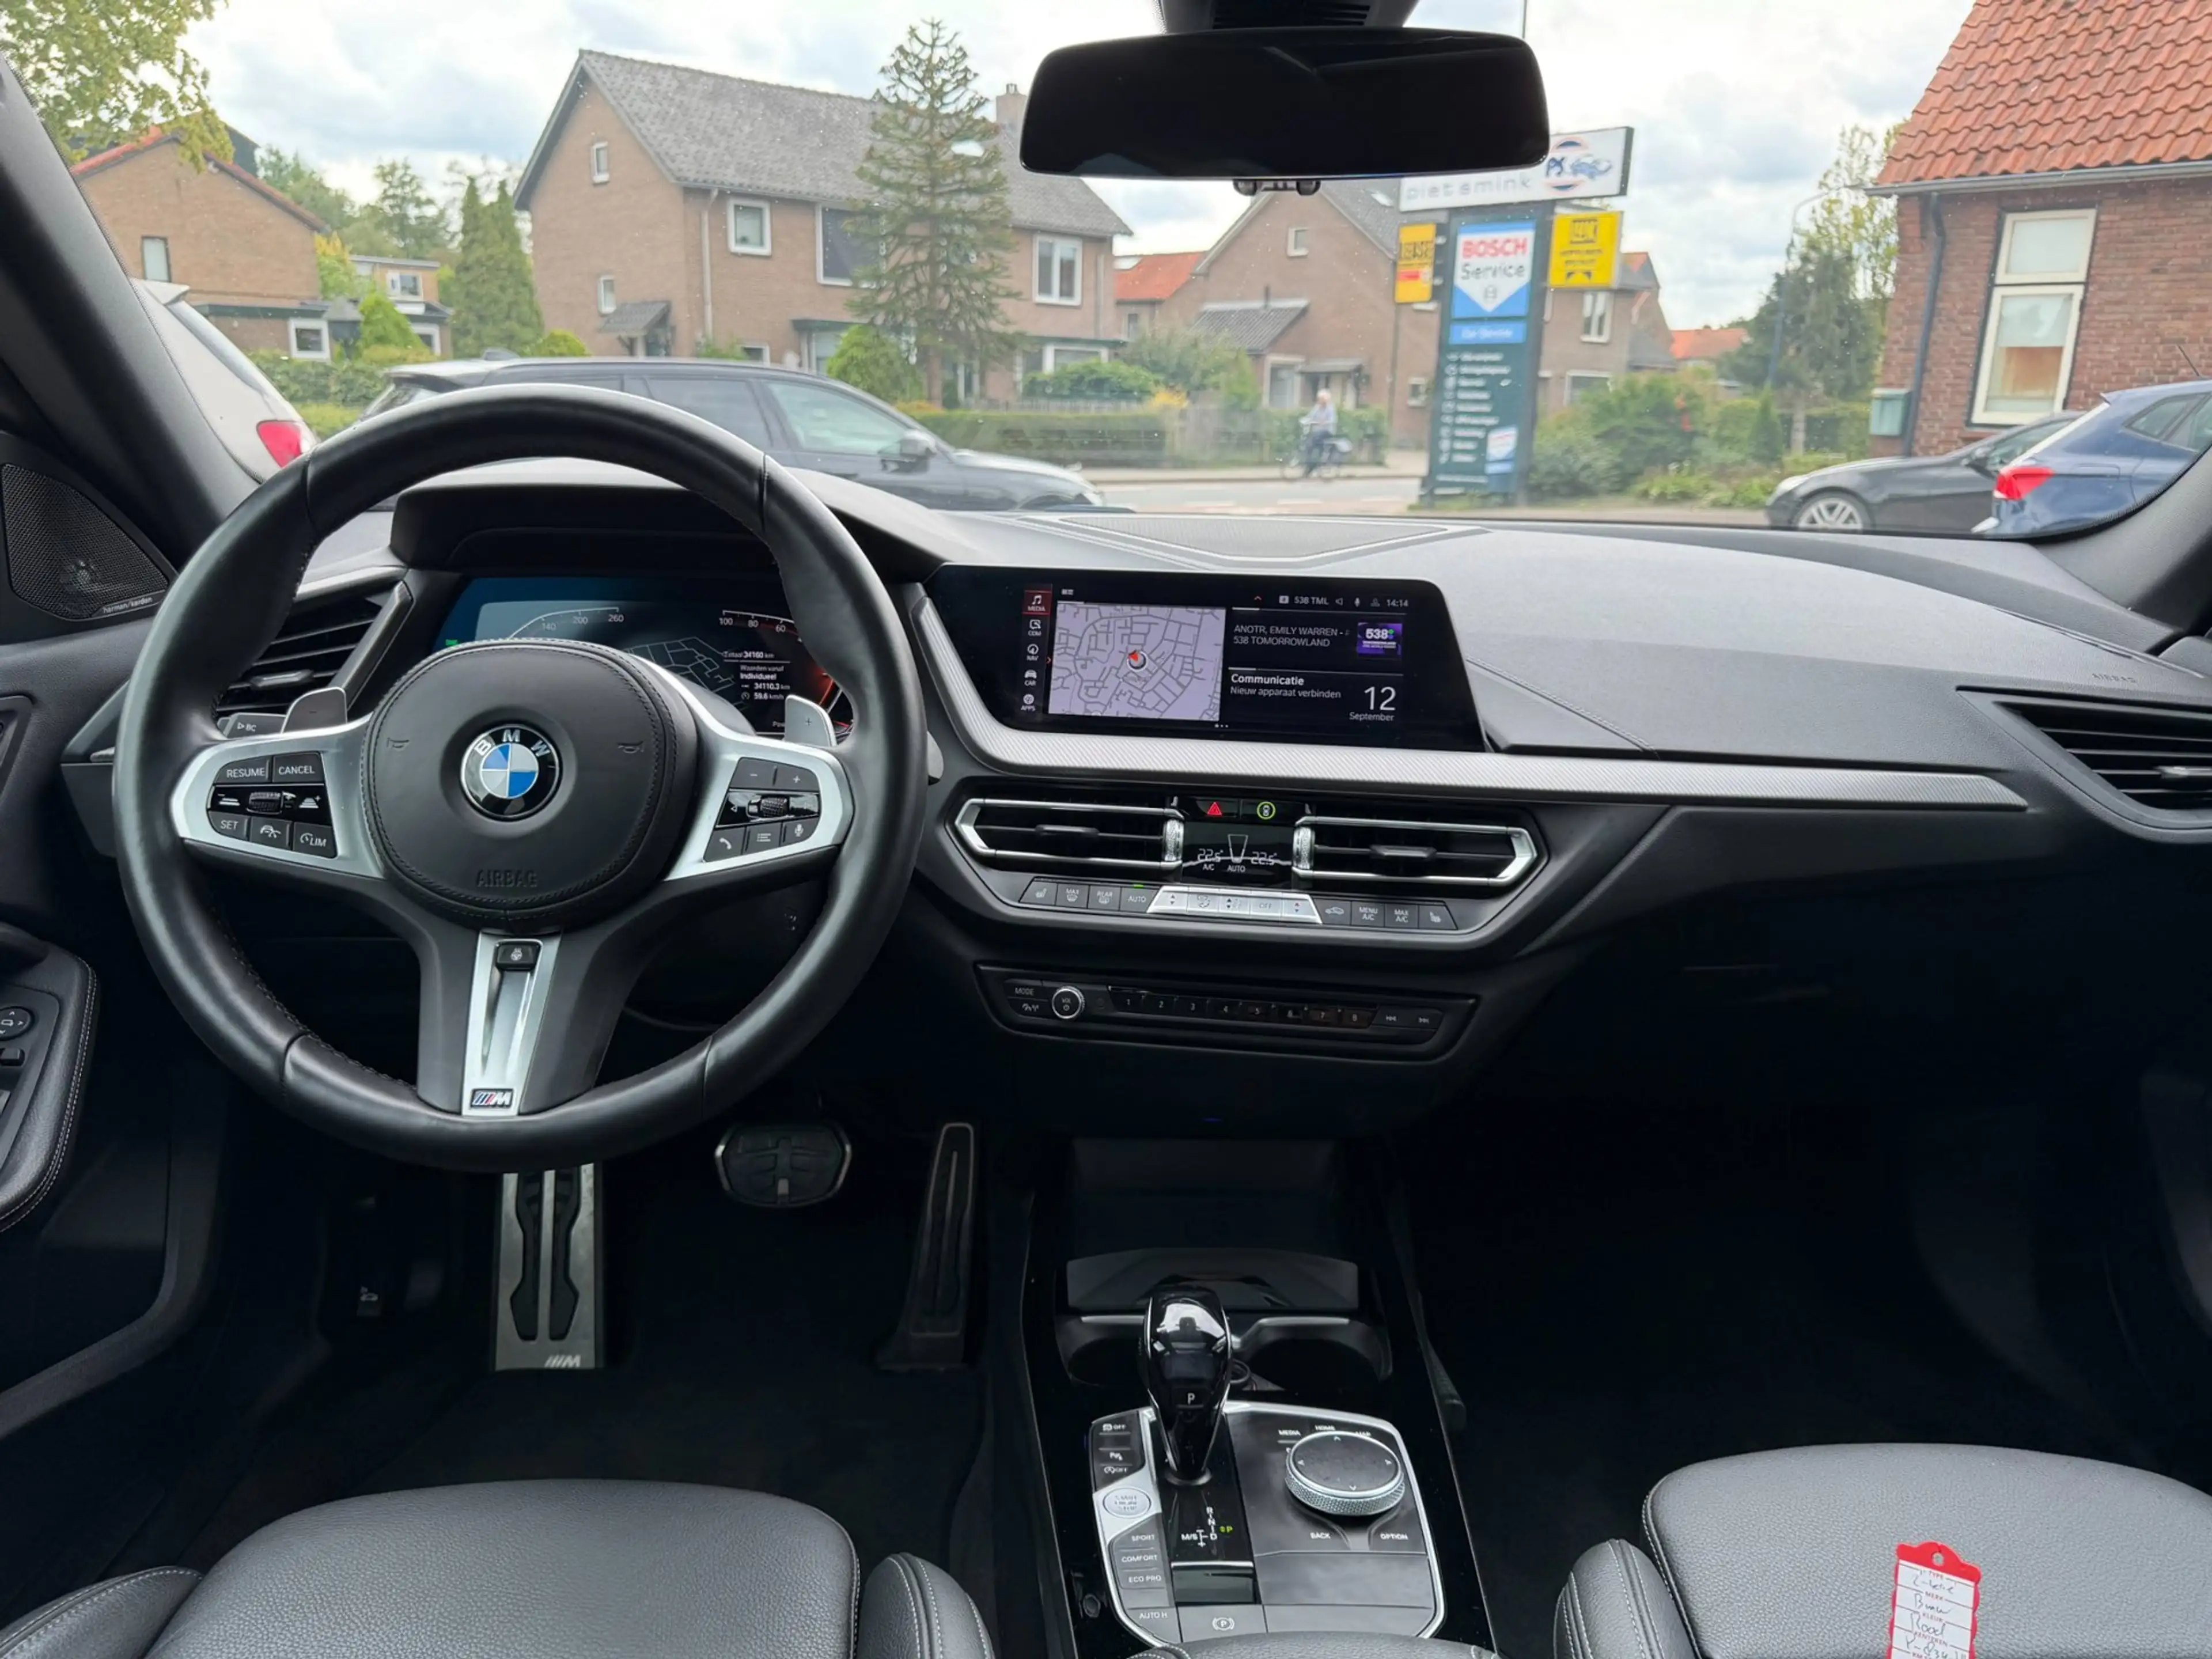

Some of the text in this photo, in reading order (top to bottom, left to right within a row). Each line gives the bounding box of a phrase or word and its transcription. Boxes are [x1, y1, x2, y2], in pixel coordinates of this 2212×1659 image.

[1462, 237, 1528, 259] BOSCH
[1461, 263, 1525, 280] Service
[1294, 596, 1328, 605] 538 TML
[1387, 599, 1408, 607] 14:14
[573, 616, 589, 624] 200
[608, 614, 624, 623] 260
[719, 618, 733, 626] 100
[748, 619, 758, 628] 80
[542, 622, 556, 631] 140
[775, 624, 786, 633] 60
[1270, 626, 1297, 635] EMILY
[1298, 627, 1338, 636] WARREN
[1365, 628, 1388, 639] 538
[1233, 636, 1330, 646] 538 TOMORROWLAND
[1231, 673, 1305, 685] Communicatie
[1230, 687, 1341, 699] Nieuw apparaat verbinden
[1363, 686, 1396, 711] 12
[1349, 711, 1395, 722] September
[245, 724, 257, 732] BC
[474, 729, 551, 757] BMW
[226, 767, 266, 778] RESUME
[278, 765, 315, 775] CANCEL
[220, 820, 238, 830] SET
[309, 838, 327, 847] LIM
[1226, 865, 1246, 873] AUTO
[476, 869, 538, 888] AIRBAG
[1014, 987, 1035, 995] MODE
[1187, 1393, 1195, 1404] P
[1380, 1532, 1409, 1540] OPTION
[1121, 1554, 1158, 1563] COMFORT
